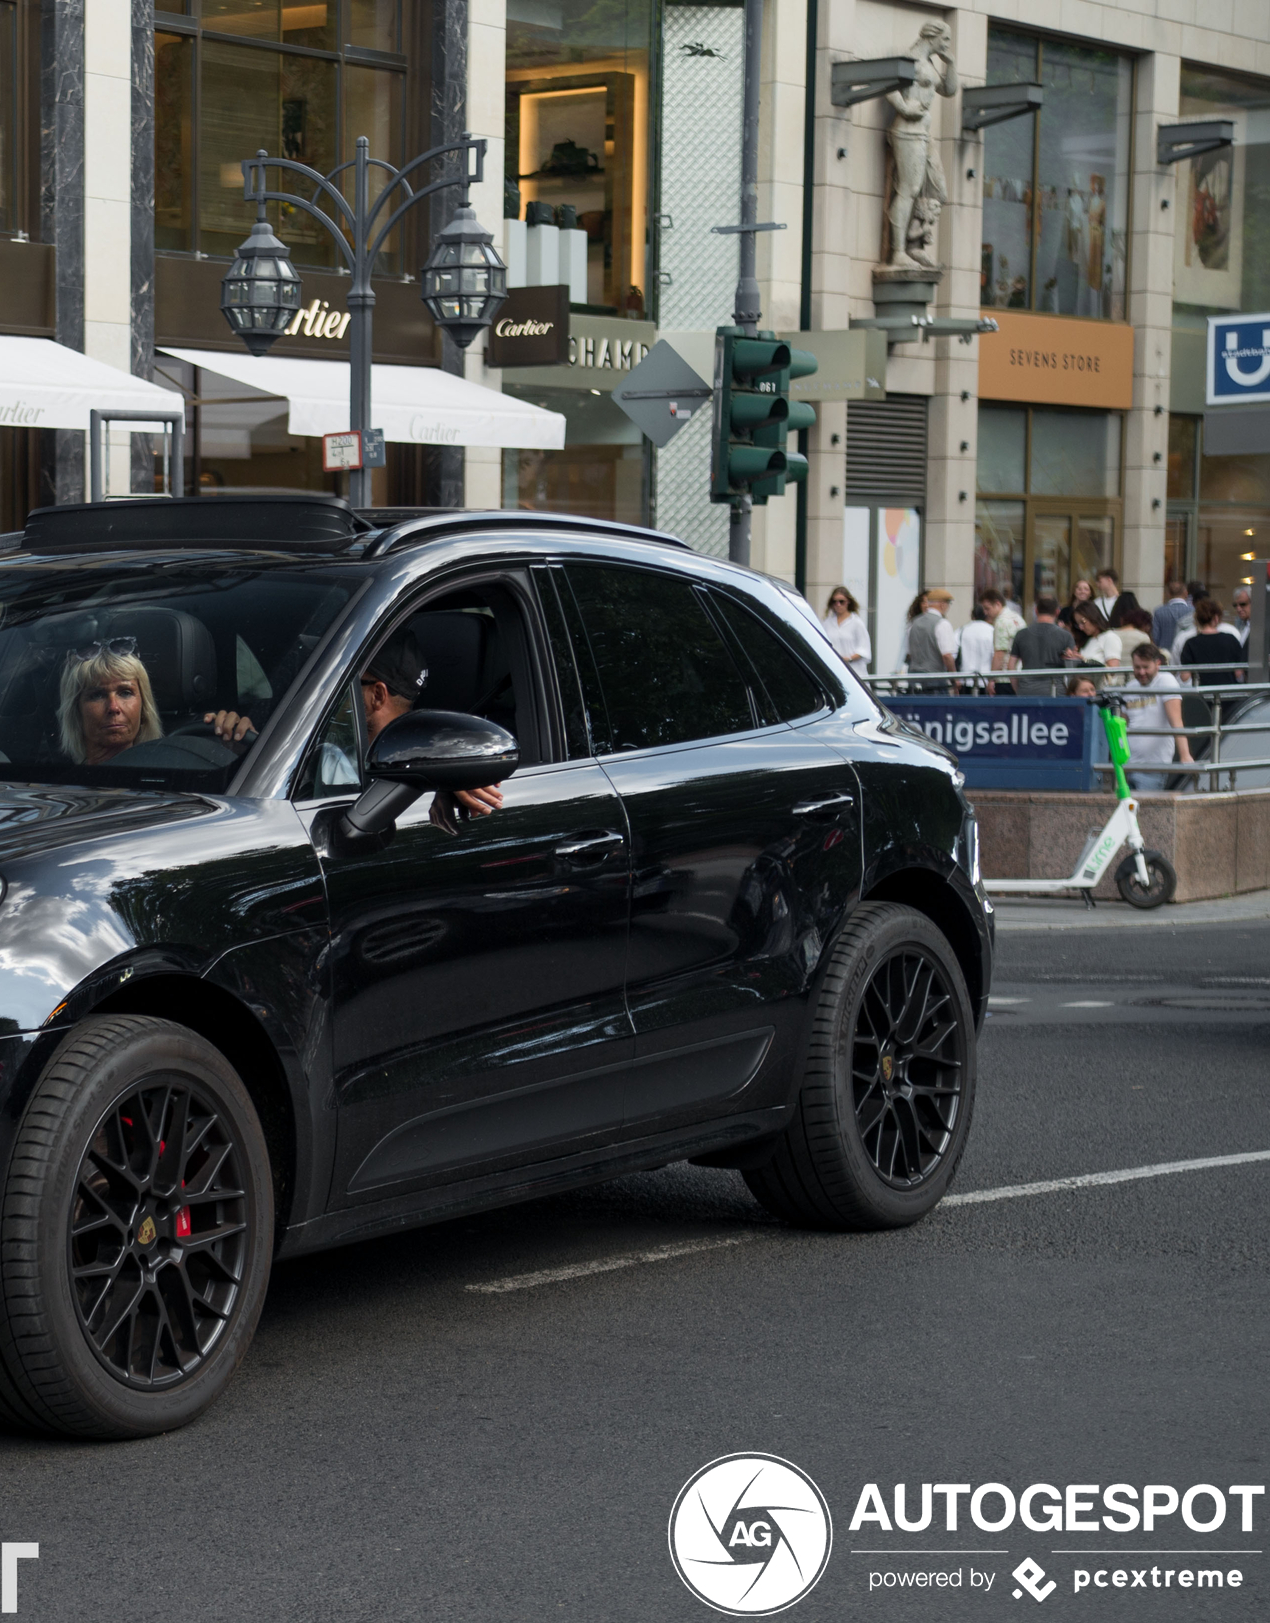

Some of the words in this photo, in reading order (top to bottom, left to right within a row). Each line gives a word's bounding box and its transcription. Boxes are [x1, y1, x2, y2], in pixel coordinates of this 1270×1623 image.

[284, 298, 351, 339] rtier
[495, 318, 554, 338] Cartier
[1010, 348, 1057, 370] SEVENS
[1063, 353, 1100, 373] STORE
[409, 413, 461, 443] Cartier
[1085, 836, 1116, 871] Lime
